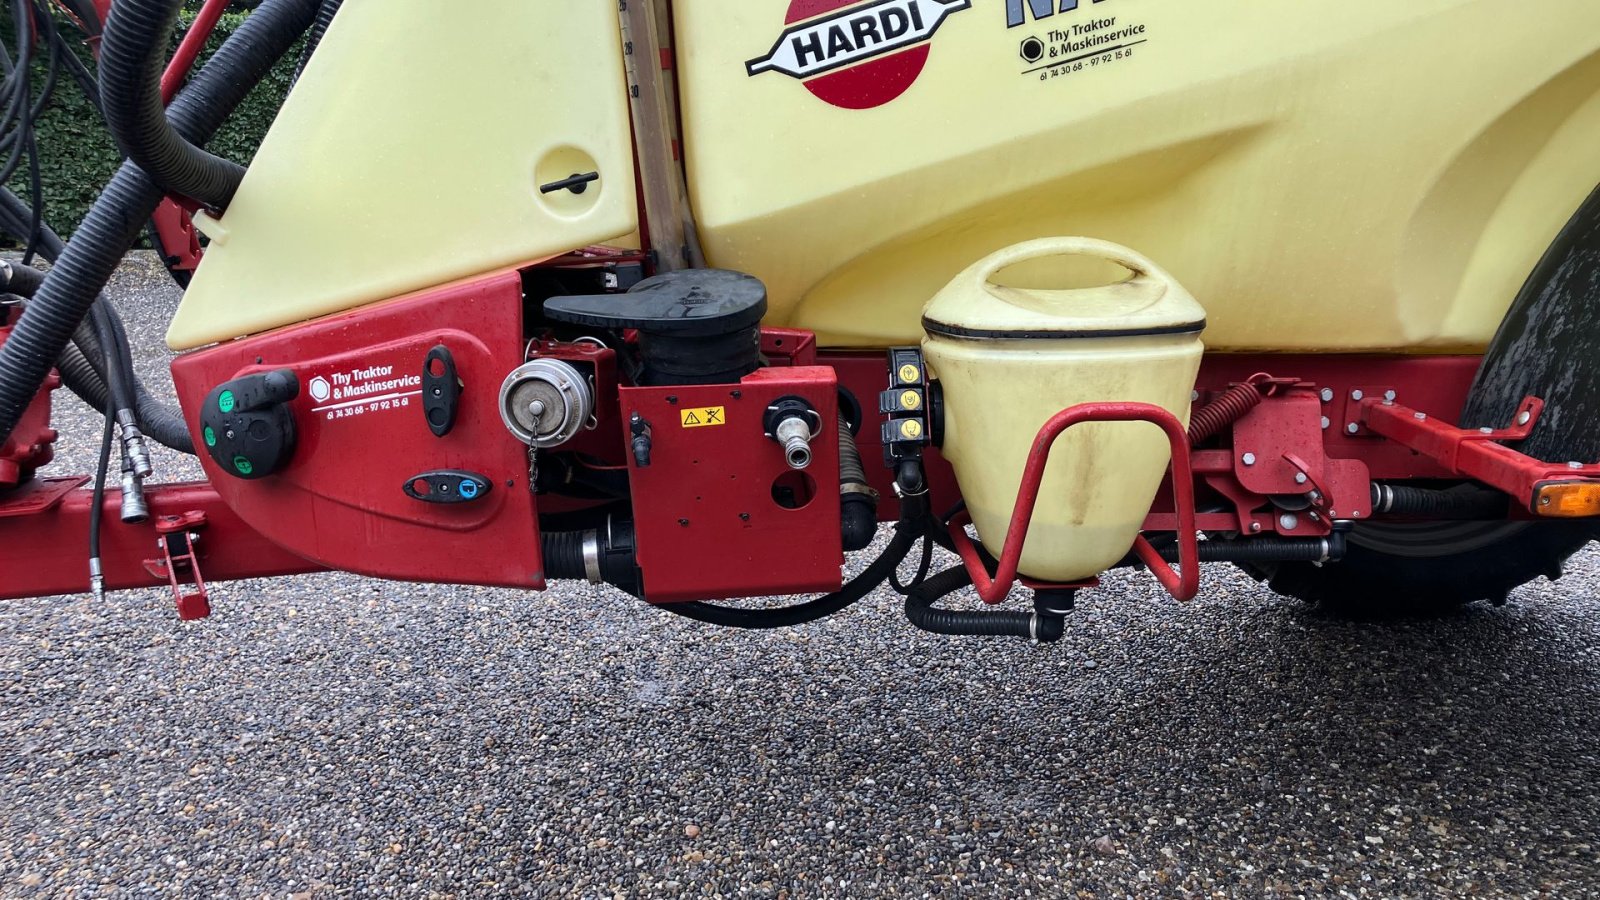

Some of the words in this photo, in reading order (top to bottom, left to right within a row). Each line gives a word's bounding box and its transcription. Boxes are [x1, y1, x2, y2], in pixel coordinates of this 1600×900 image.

[791, 1, 924, 68] HARDI
[1048, 30, 1069, 42] Thy
[1072, 17, 1116, 35] Traktor
[1049, 47, 1058, 58] &
[1061, 24, 1145, 55] Maskinservice
[1040, 72, 1047, 81] 61
[1051, 69, 1059, 78] 74
[1061, 66, 1070, 75] 30
[1073, 62, 1083, 71] 68
[1091, 57, 1099, 66] 97
[1102, 54, 1112, 63] 92
[1115, 51, 1123, 60] 15
[1125, 48, 1132, 57] 61
[331, 373, 351, 385] Thy
[352, 366, 392, 380] Traktor
[334, 388, 342, 398] &
[344, 375, 420, 397] Maskinservice
[345, 407, 354, 416] 30
[370, 402, 379, 412] 97
[380, 401, 390, 410] 92
